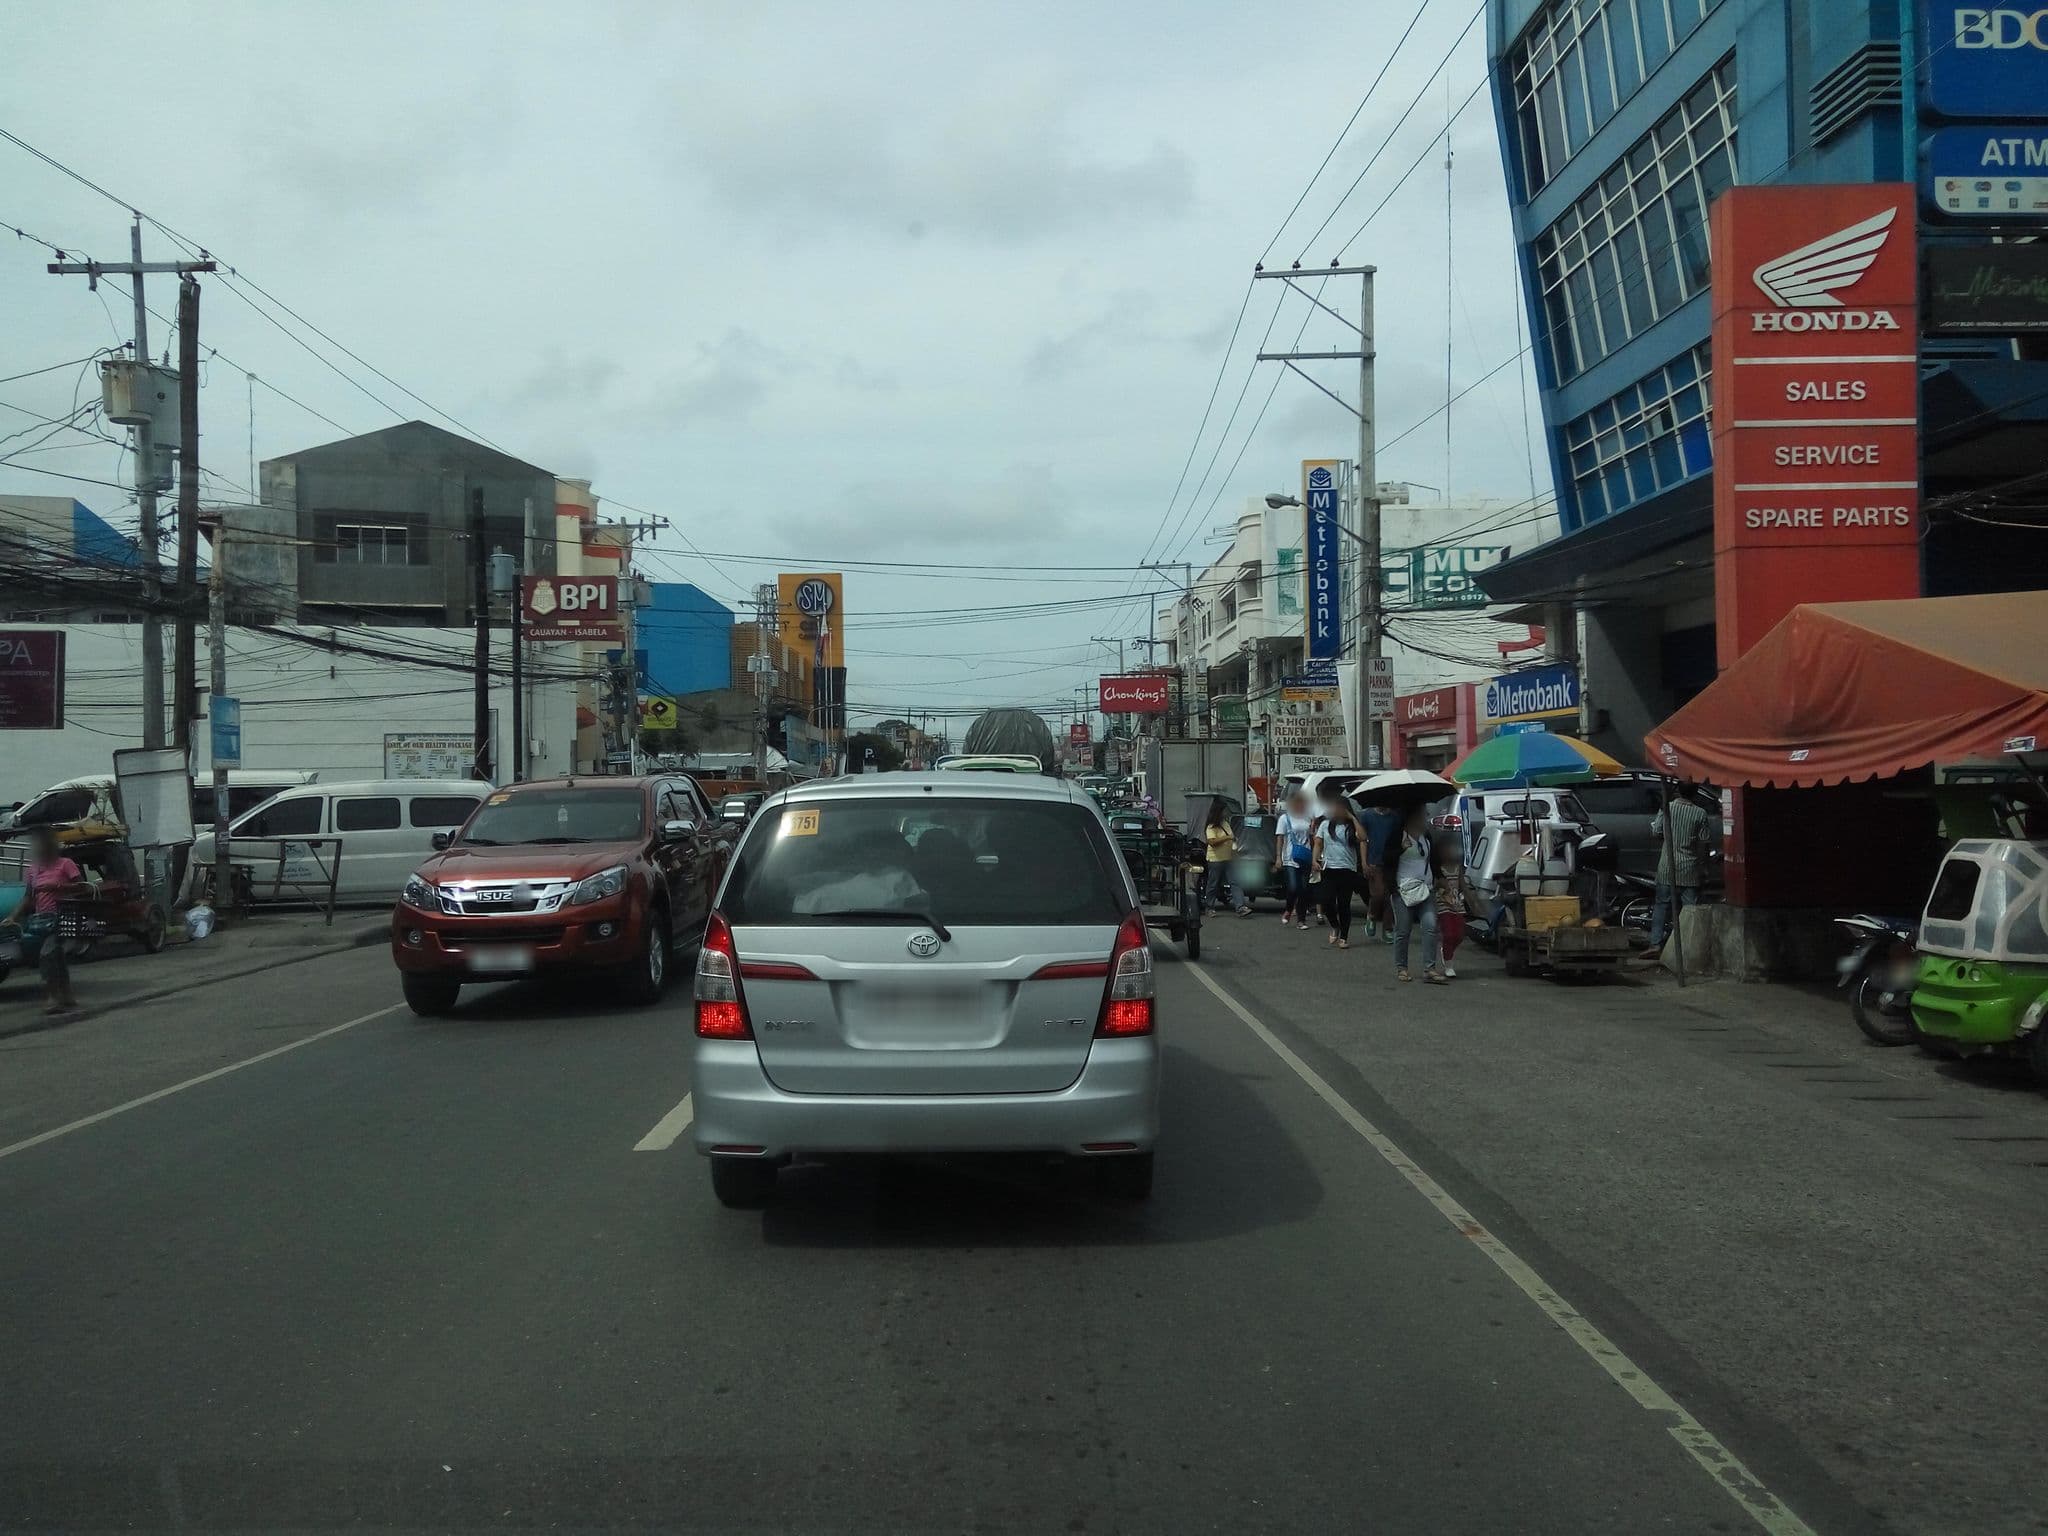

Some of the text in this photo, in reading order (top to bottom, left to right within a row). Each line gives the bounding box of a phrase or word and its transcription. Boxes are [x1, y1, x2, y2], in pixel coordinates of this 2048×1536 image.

[1980, 138, 2048, 166] ATM
[1751, 310, 1901, 332] HONDA
[1786, 380, 1867, 401] SALES
[1775, 444, 1880, 466] SERVICE
[1745, 506, 1910, 528] SPARE PARTS
[1312, 491, 1330, 639] Metrobank
[560, 584, 607, 610] BPI
[799, 583, 828, 611] SM
[1374, 660, 1386, 671] NO
[1369, 675, 1393, 689] PARKING
[1103, 687, 1159, 703] Chowking
[1500, 674, 1572, 716] Metrobank
[1275, 726, 1346, 737] RENEW LUMBER
[1286, 717, 1335, 727] HIGHWAY
[1275, 737, 1332, 746] & HARDWARE
[1294, 756, 1330, 764] BODEGA
[479, 891, 514, 901] ISUZ
